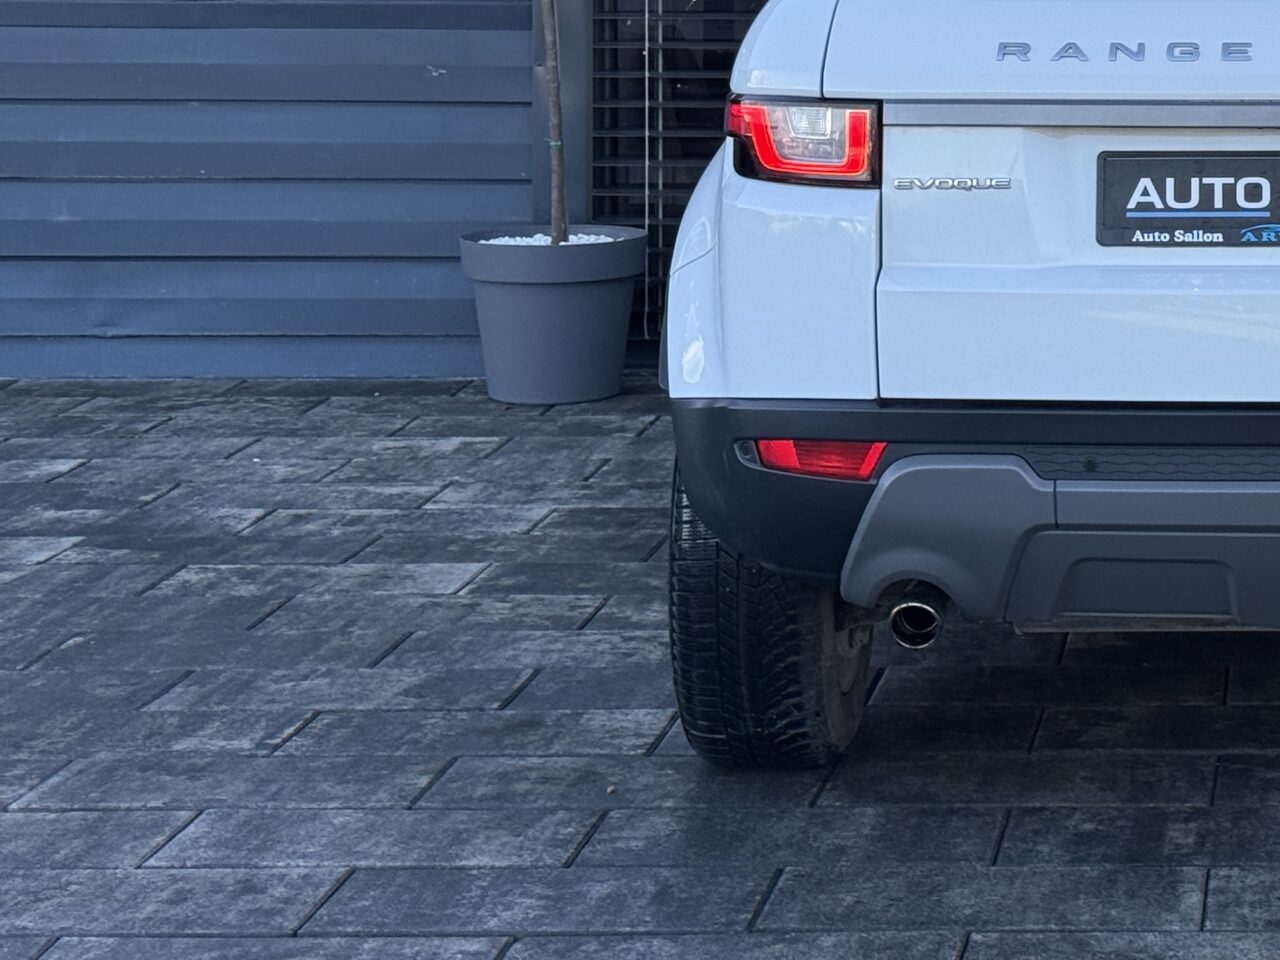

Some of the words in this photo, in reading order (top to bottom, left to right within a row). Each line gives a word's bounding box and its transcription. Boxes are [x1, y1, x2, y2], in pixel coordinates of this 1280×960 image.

[996, 42, 1253, 62] RANGE
[894, 178, 1011, 191] EVOQUE
[1126, 177, 1271, 209] AUTO
[1132, 230, 1170, 242] Auto
[1173, 229, 1224, 243] Sallon
